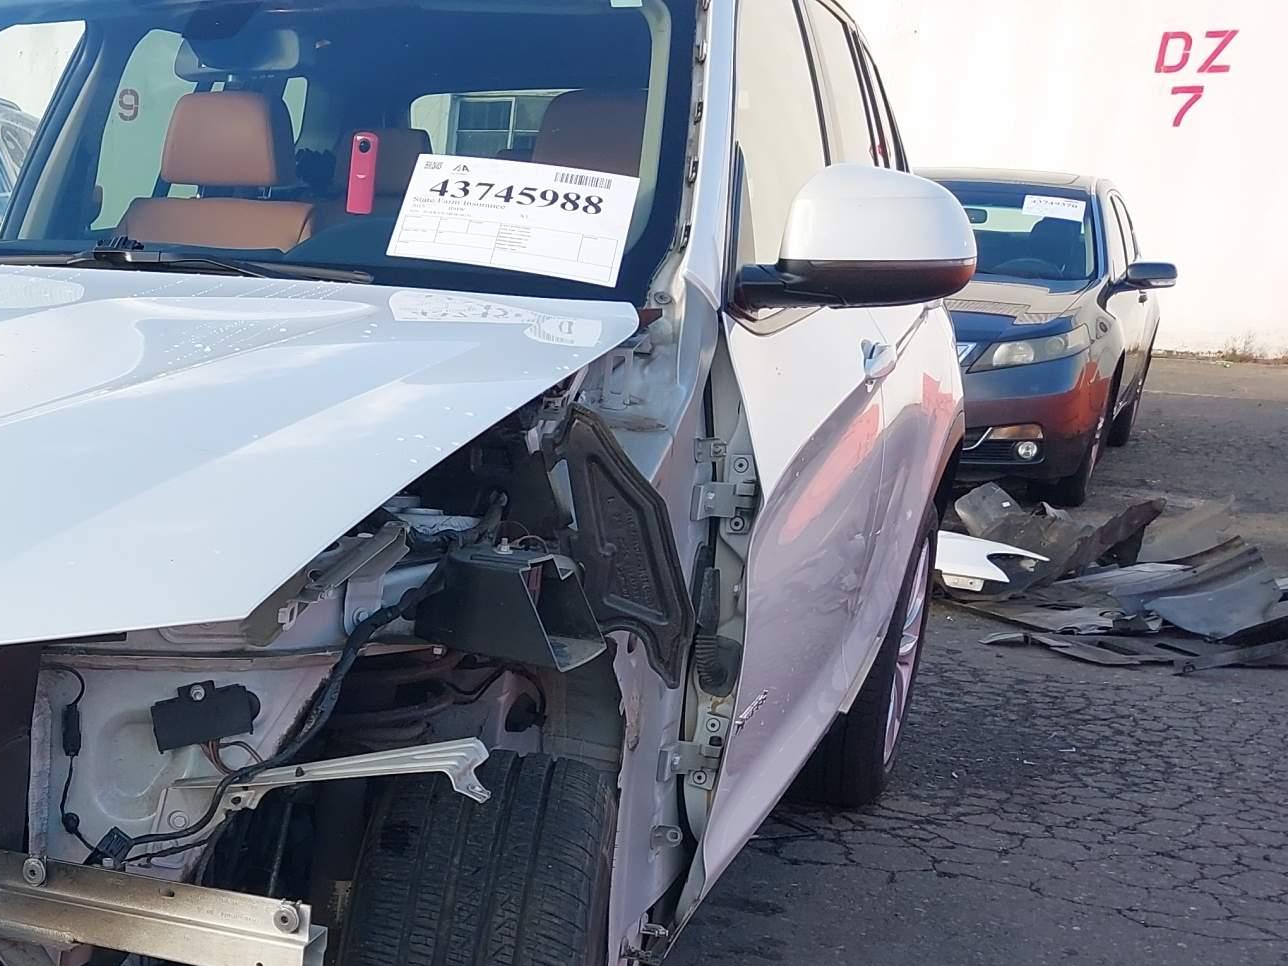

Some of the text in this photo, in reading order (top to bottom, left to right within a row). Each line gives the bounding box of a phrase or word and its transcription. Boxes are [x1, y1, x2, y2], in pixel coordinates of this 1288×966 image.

[1154, 29, 1240, 74] DZ
[118, 88, 139, 121] 9
[1171, 85, 1205, 128] 7
[429, 178, 604, 215] 43745988
